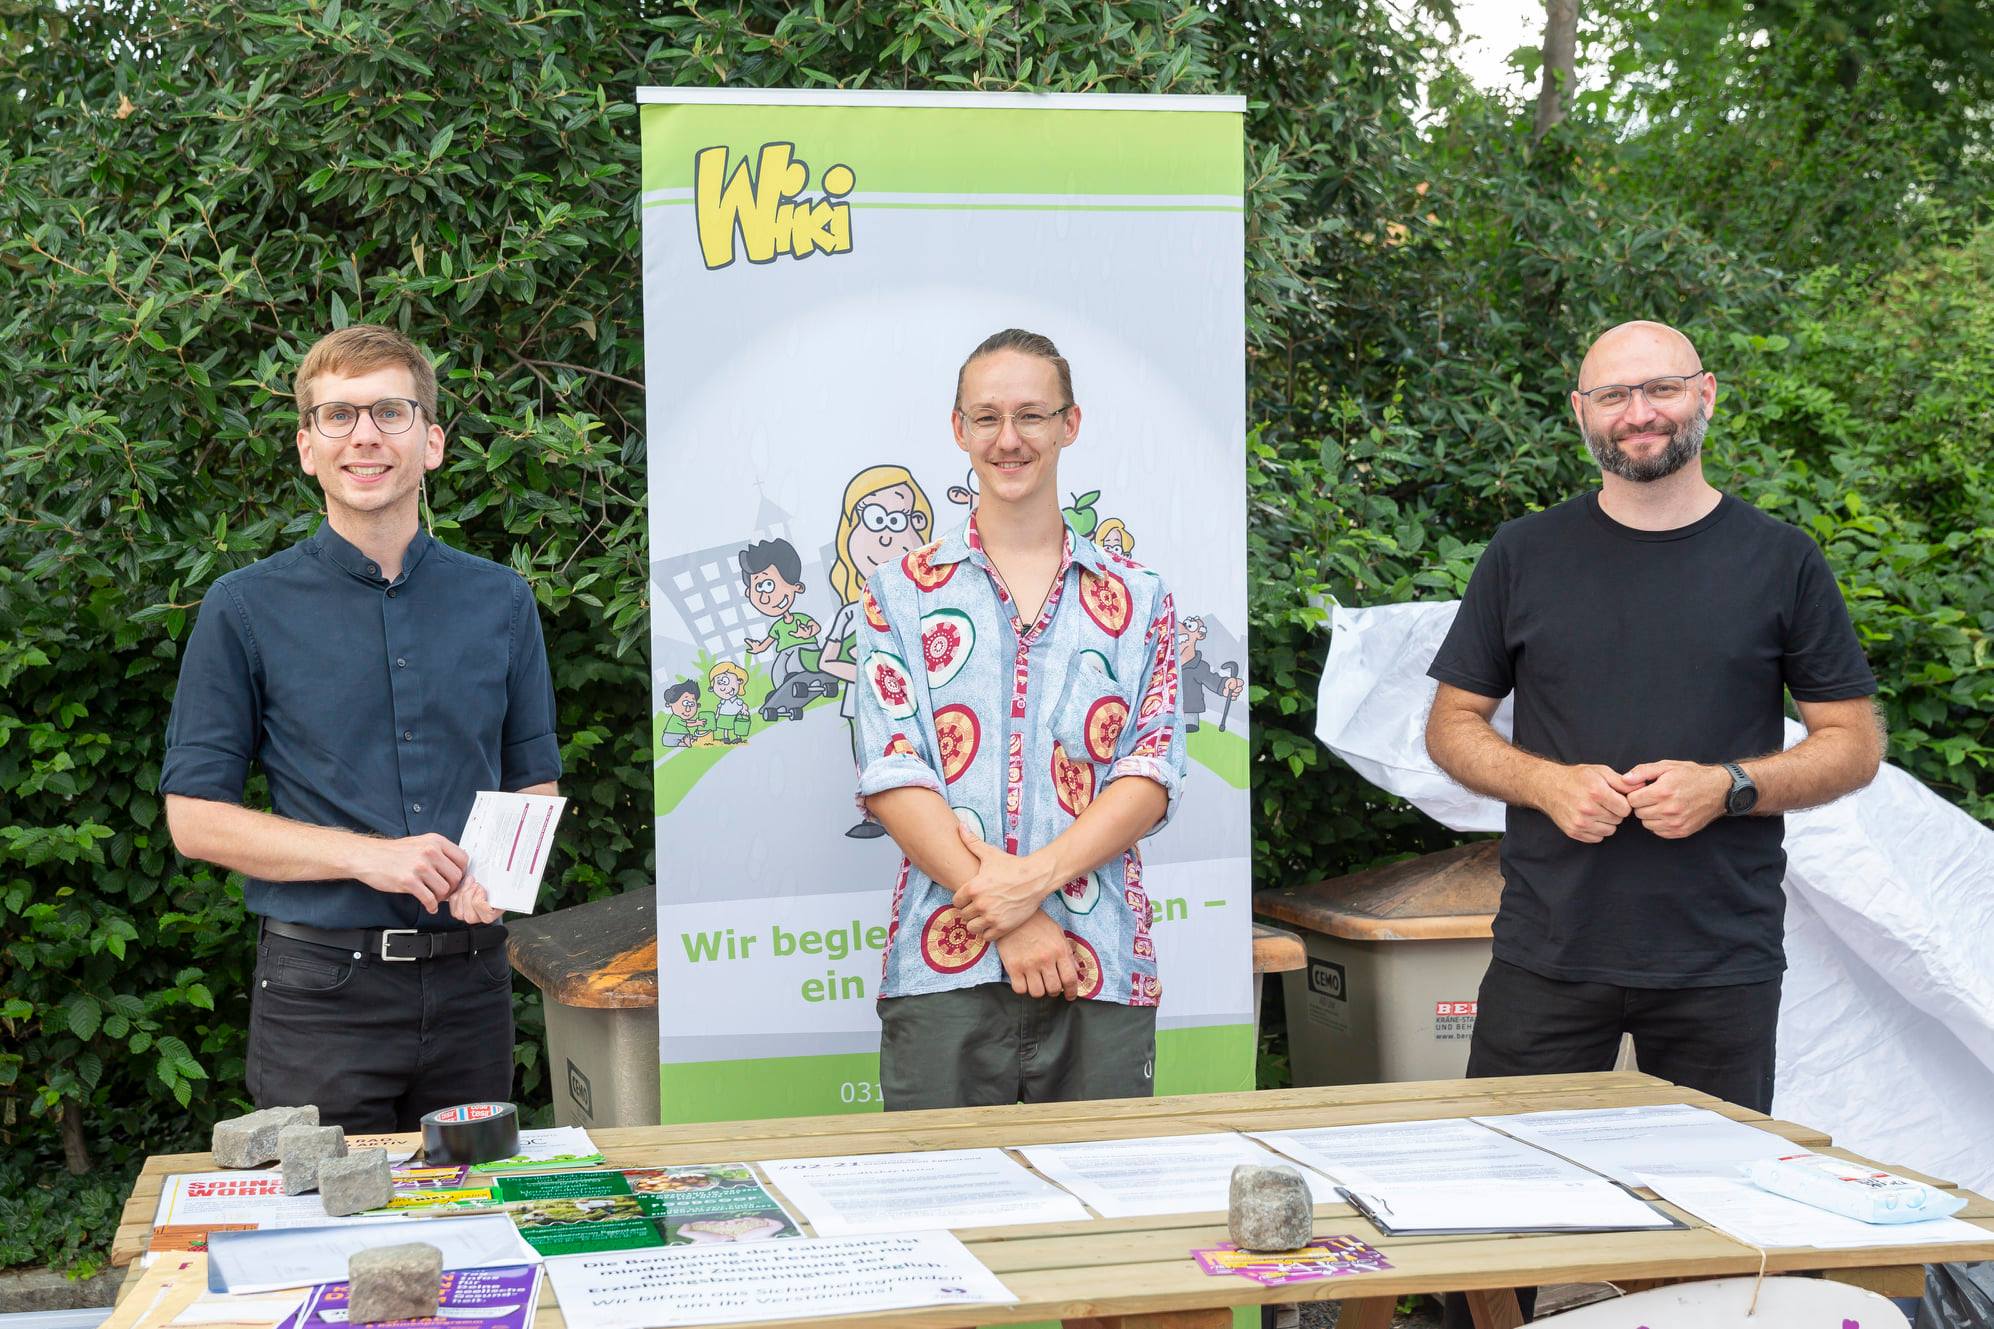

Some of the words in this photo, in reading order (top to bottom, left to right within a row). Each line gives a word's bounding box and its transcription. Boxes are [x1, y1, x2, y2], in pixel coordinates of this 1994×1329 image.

[681, 929, 757, 963] Wir
[772, 919, 888, 961] begle
[801, 969, 865, 1003] ein
[1315, 969, 1340, 992] CEMO
[840, 1082, 884, 1103] 031
[774, 1250, 873, 1261] Personen
[641, 1271, 702, 1280] durch
[592, 1298, 627, 1306] Wir
[639, 1294, 702, 1302] bitten
